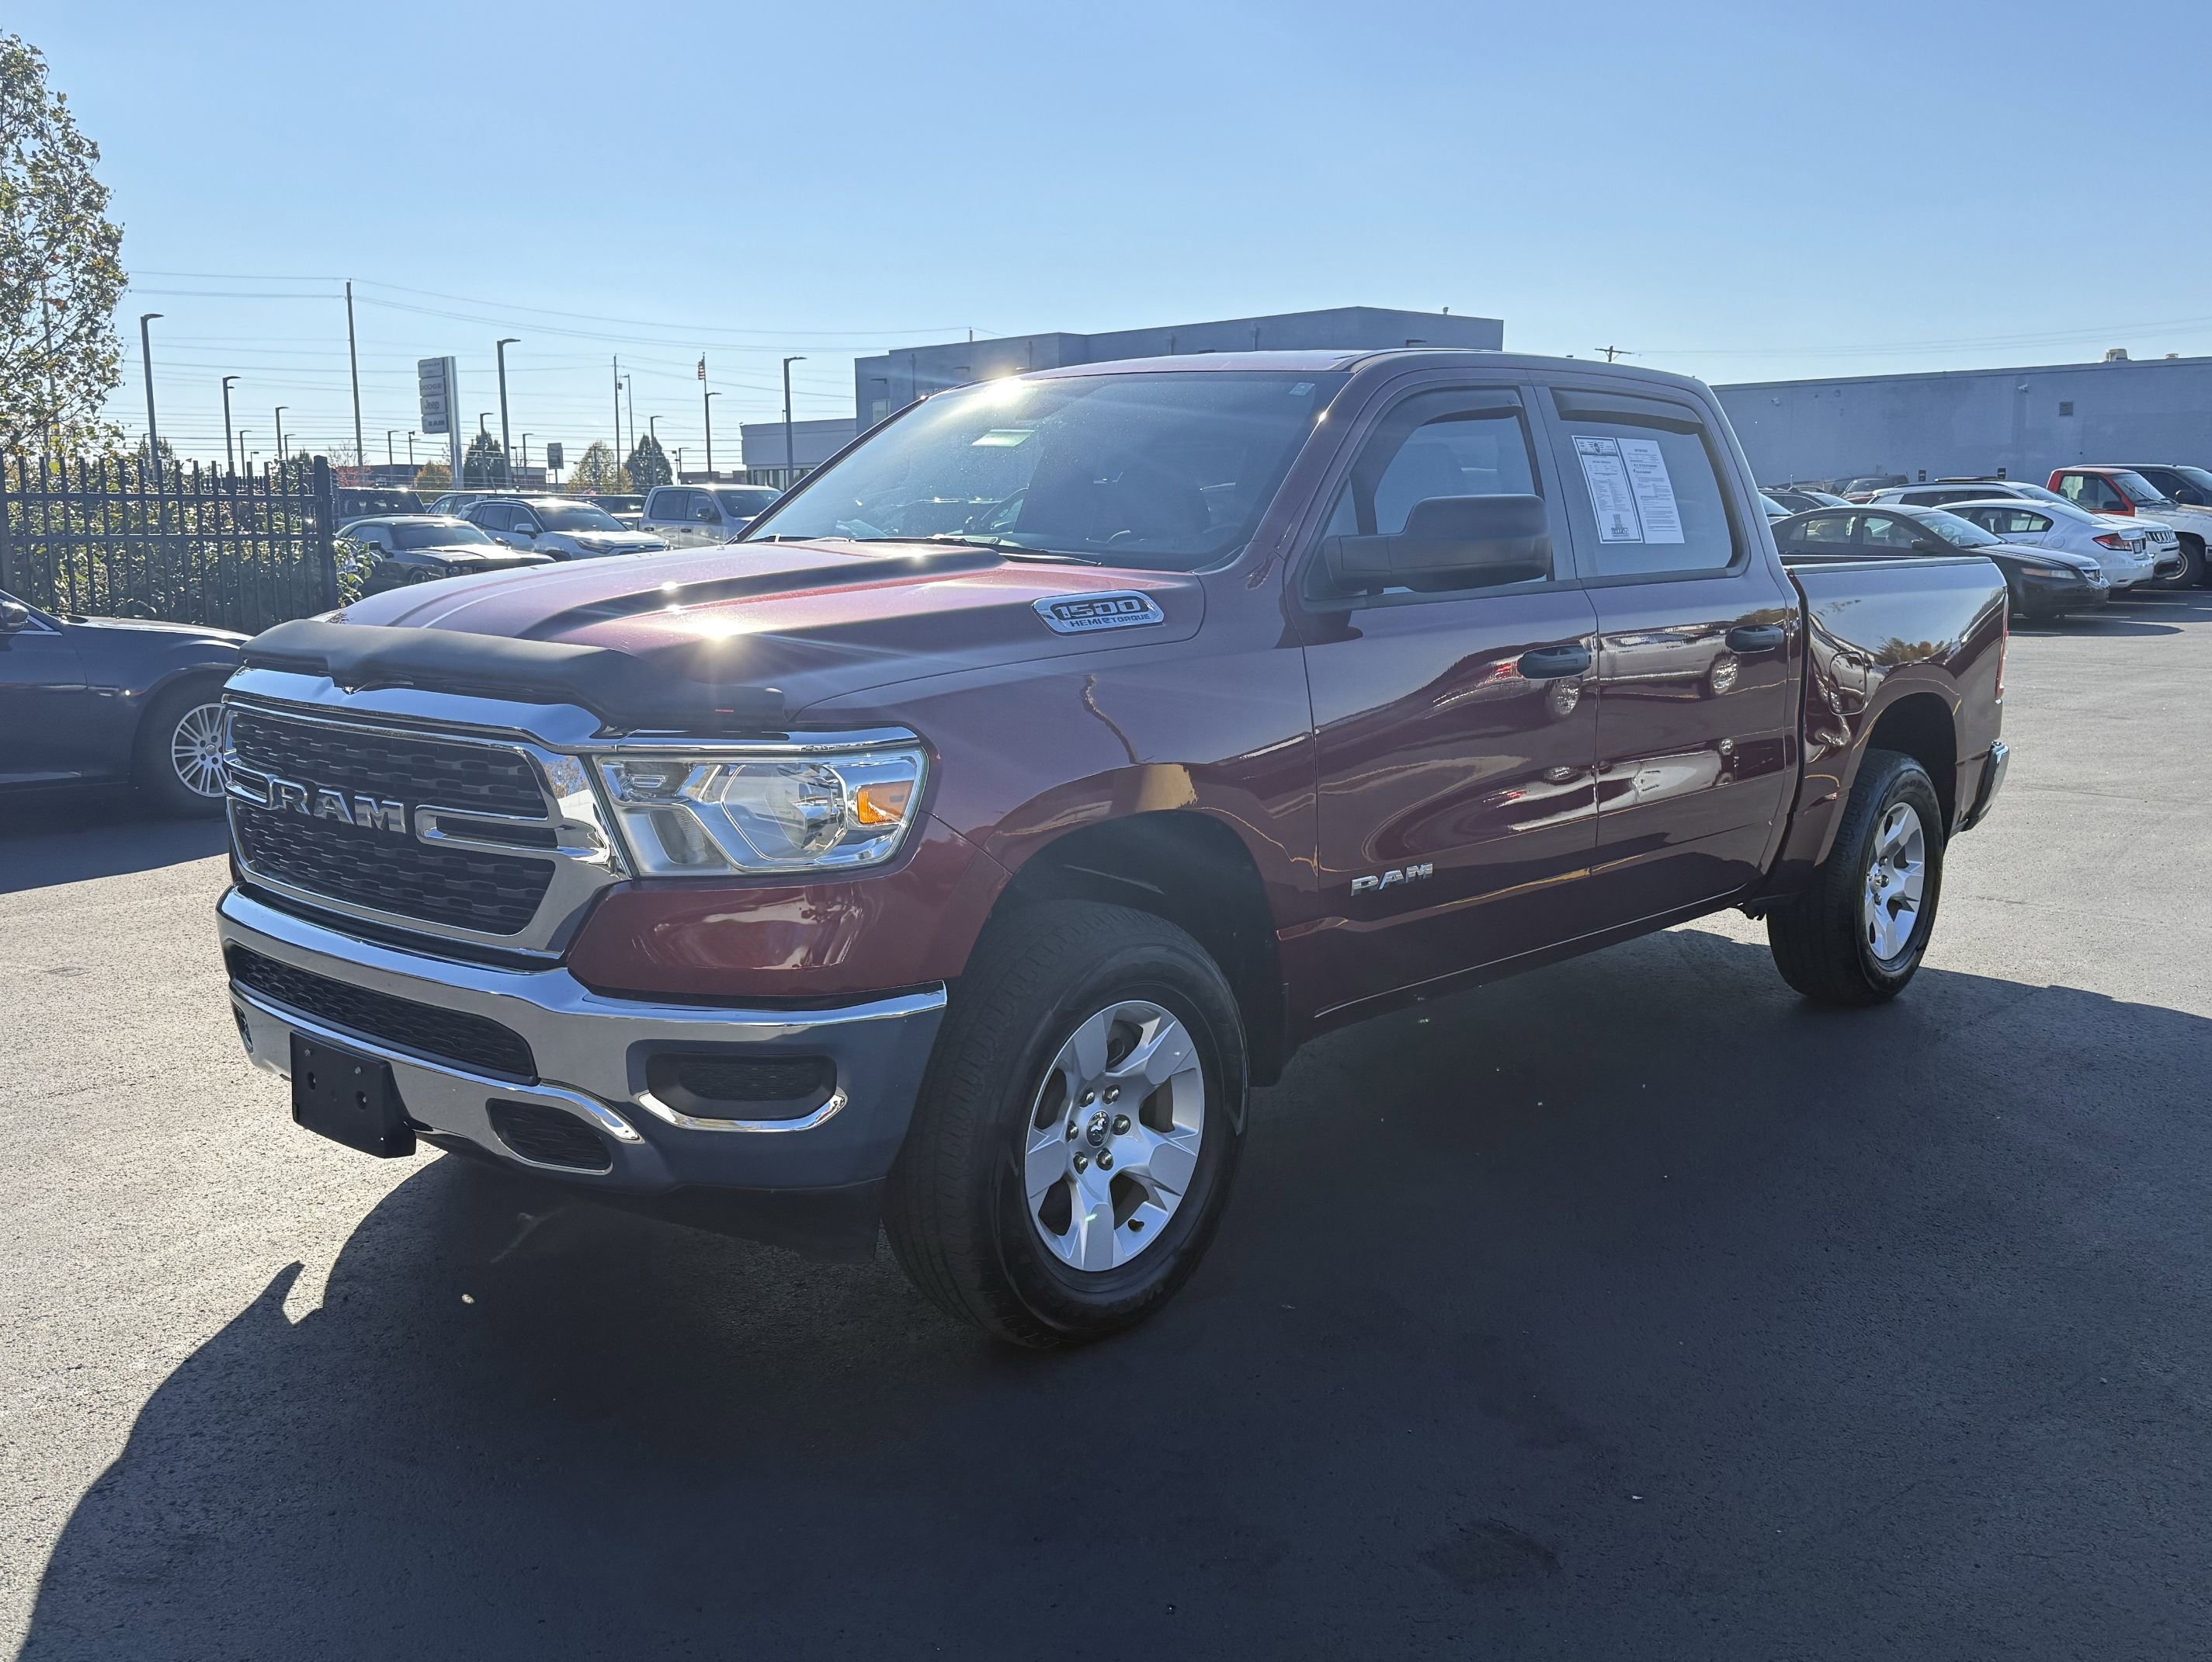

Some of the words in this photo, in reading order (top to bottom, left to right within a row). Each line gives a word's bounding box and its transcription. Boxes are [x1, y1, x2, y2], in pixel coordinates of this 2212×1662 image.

[424, 399, 440, 411] Jeep
[1055, 599, 1141, 619] 1500
[1070, 618, 1103, 628] HEMI
[272, 777, 407, 834] RAM
[1351, 862, 1433, 896] RAM
